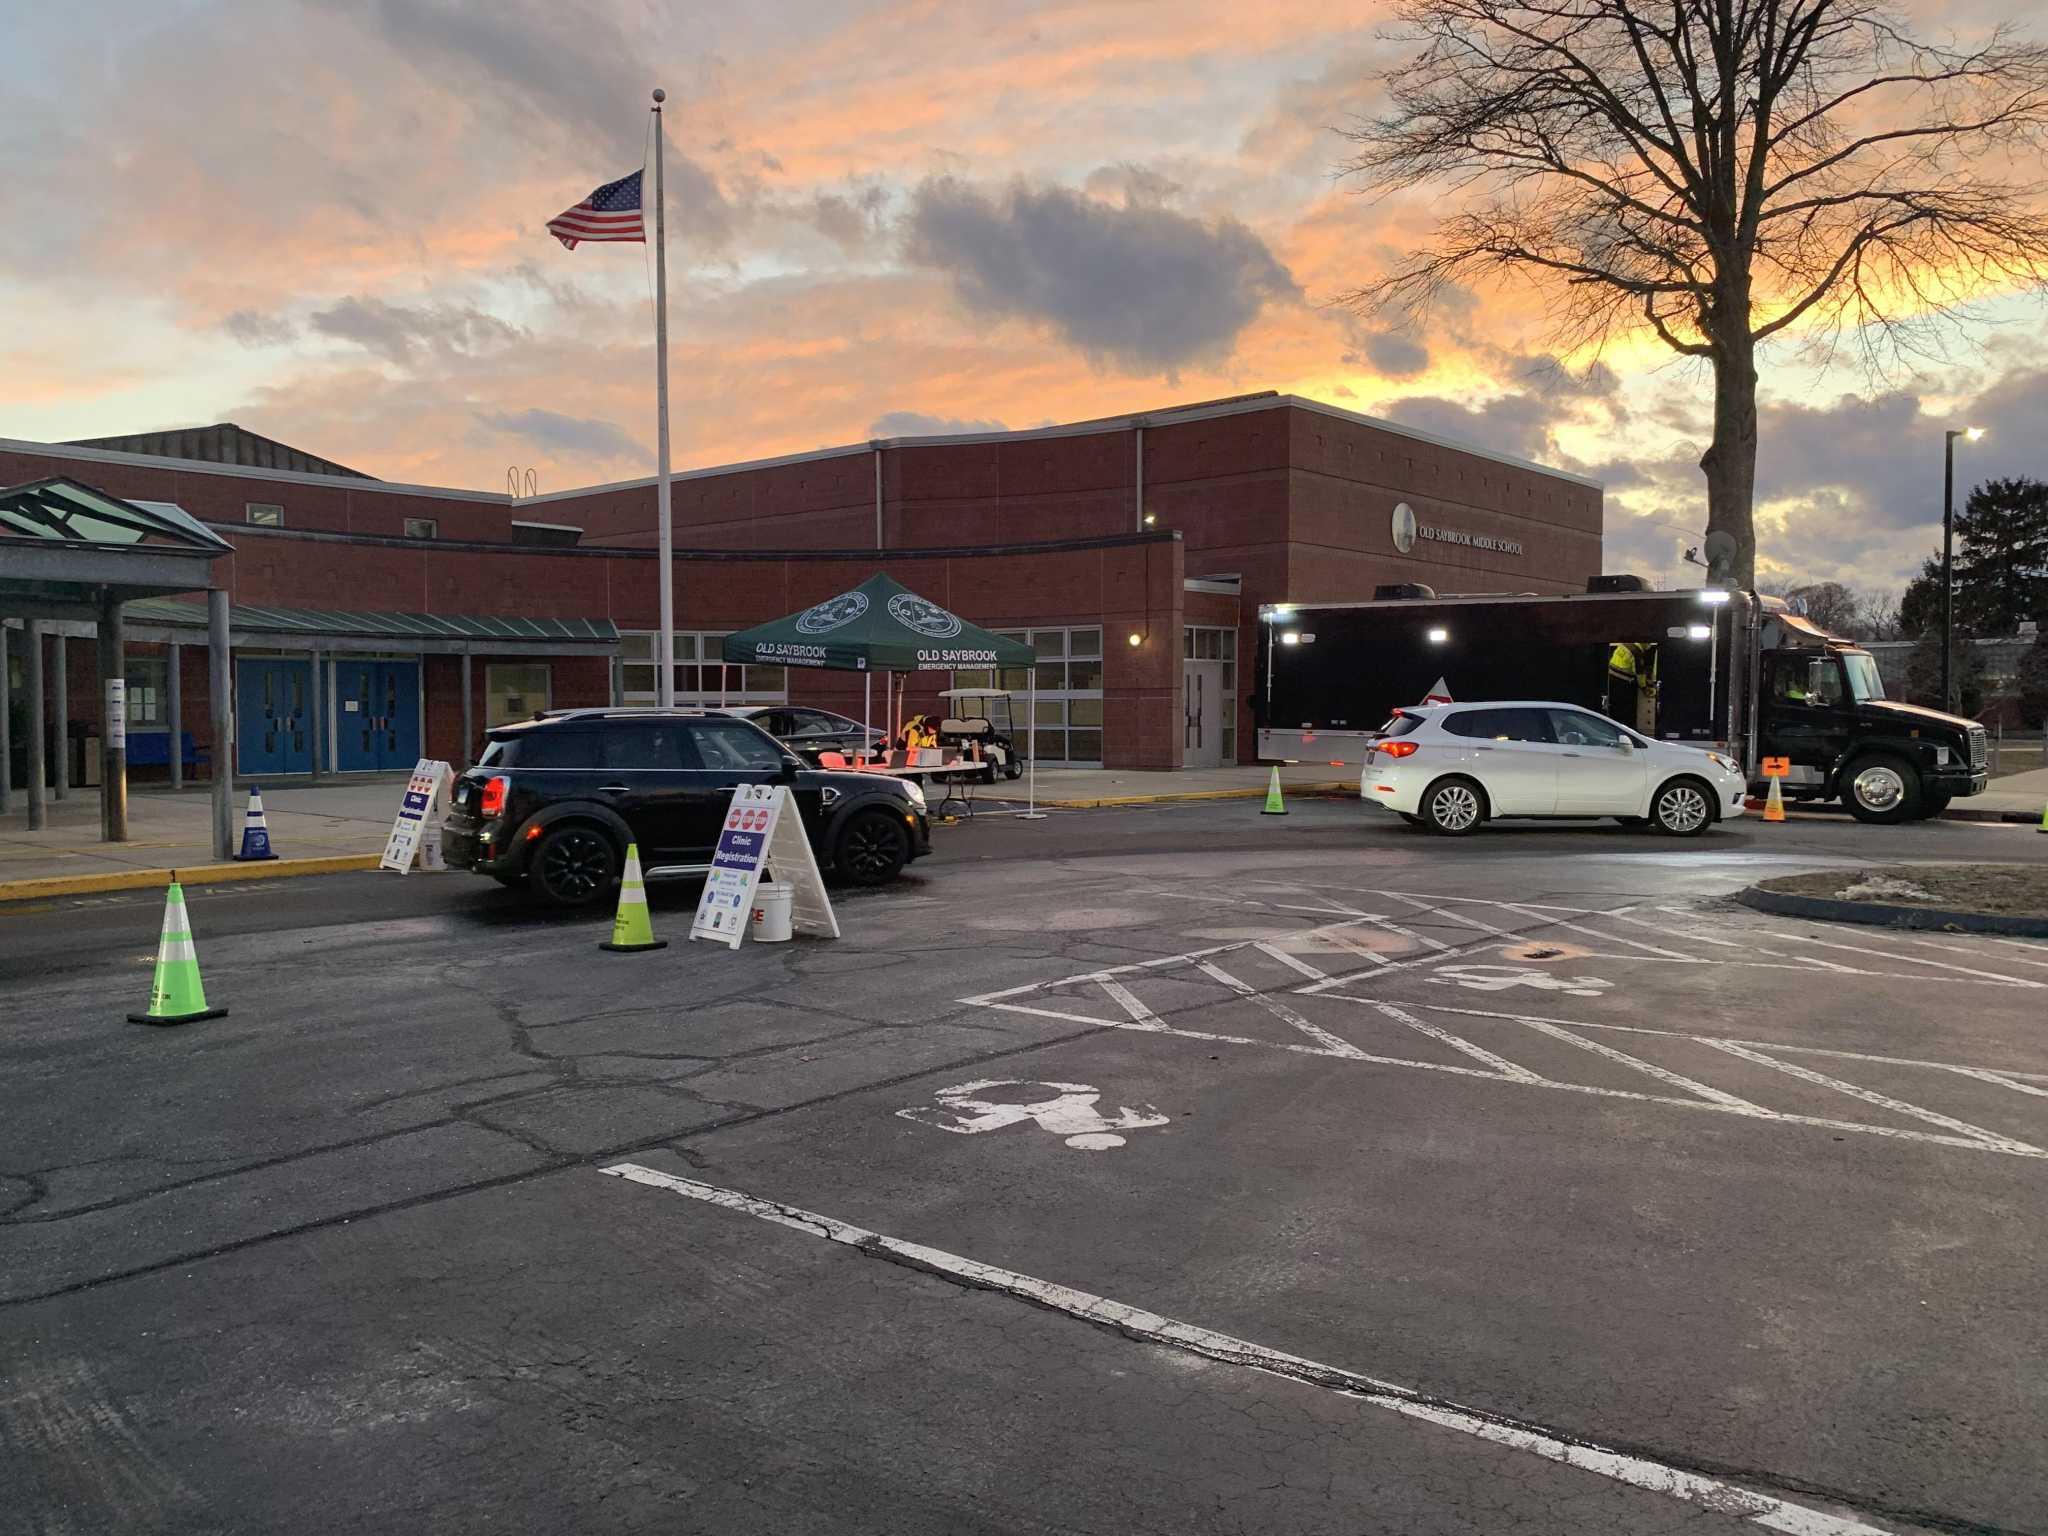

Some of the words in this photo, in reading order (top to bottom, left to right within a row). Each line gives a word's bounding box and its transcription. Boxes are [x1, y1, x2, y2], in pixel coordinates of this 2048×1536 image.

[1420, 526, 1434, 539] OLD
[1435, 528, 1471, 545] SAYBROOK
[1472, 535, 1497, 550] MIDDLE
[1498, 540, 1523, 555] SCHOOL
[756, 643, 775, 654] OLD
[776, 644, 827, 658] SAYBROOK
[917, 649, 940, 661] OLD
[942, 650, 998, 661] SAYBROOK
[918, 663, 957, 671] EMERGENCY
[957, 663, 998, 671] MANAGEMENT
[731, 835, 752, 846] Clinic
[716, 850, 758, 863] Registration
